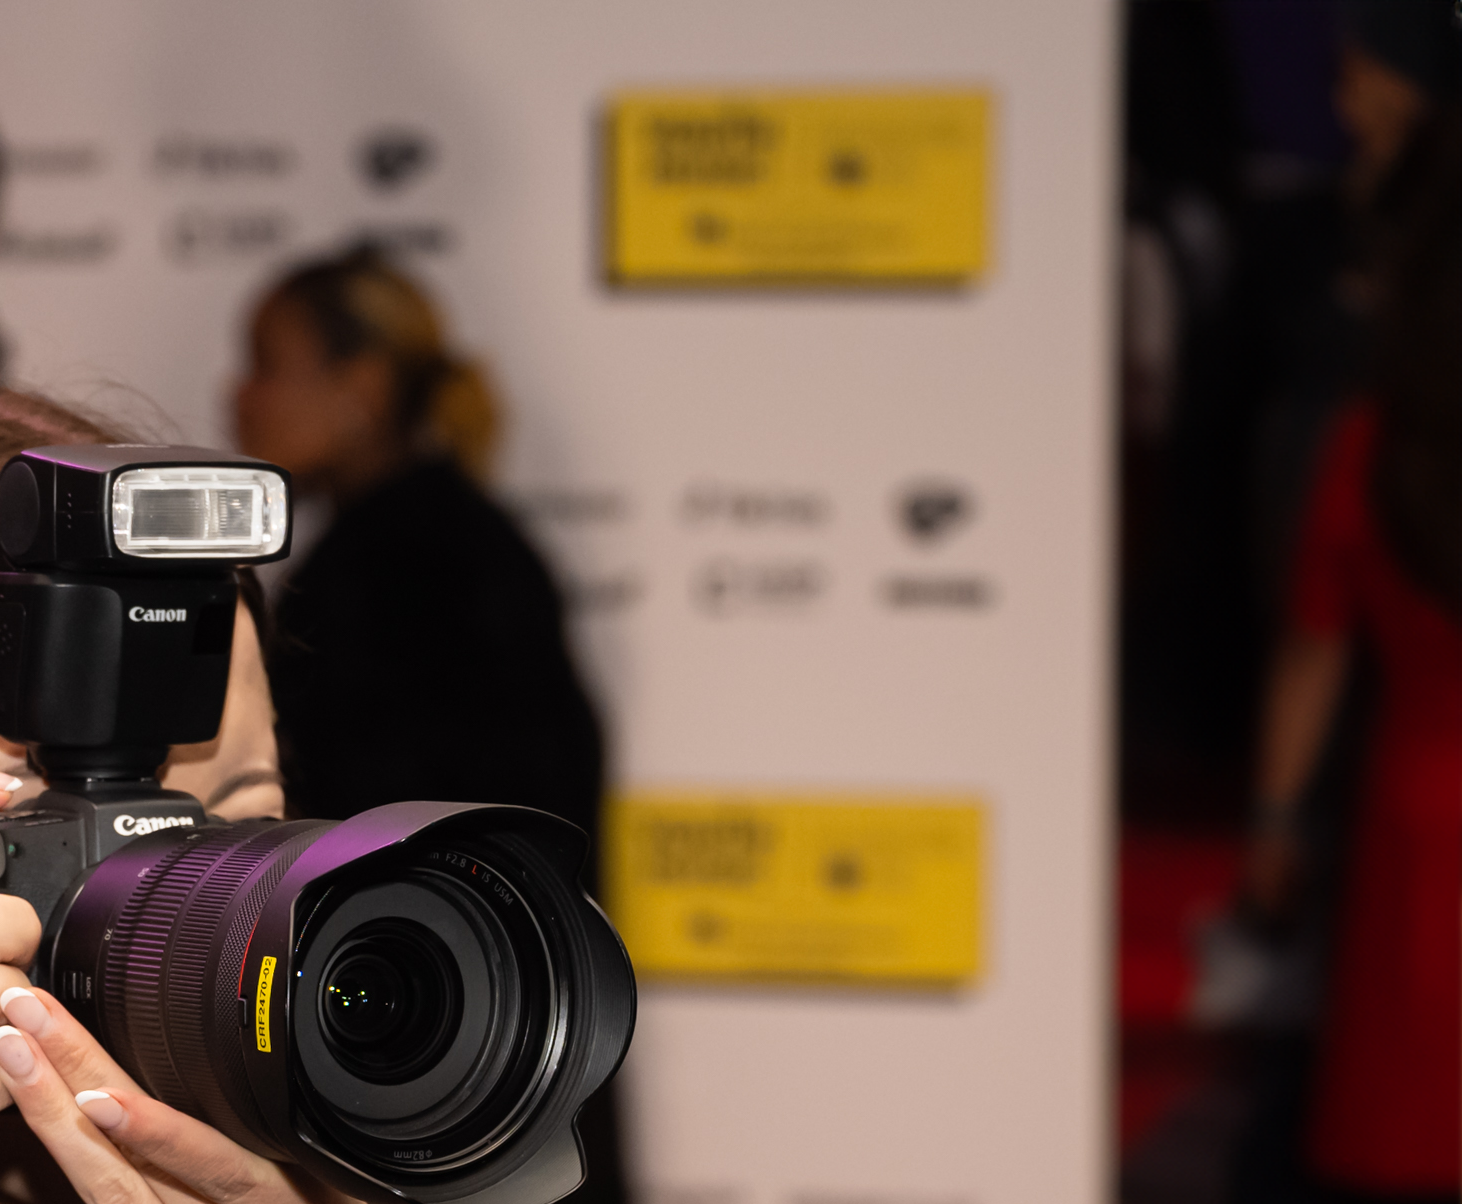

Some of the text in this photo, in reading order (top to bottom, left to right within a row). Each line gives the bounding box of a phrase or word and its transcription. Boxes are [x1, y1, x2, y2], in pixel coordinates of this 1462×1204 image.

[129, 606, 187, 622] Canon
[113, 814, 194, 836] Canon
[446, 853, 467, 868] F2.8
[472, 864, 477, 875] L
[482, 872, 491, 883] IS
[494, 883, 514, 906] USM
[104, 928, 113, 941] 70
[258, 958, 272, 1049] CRF2470-02
